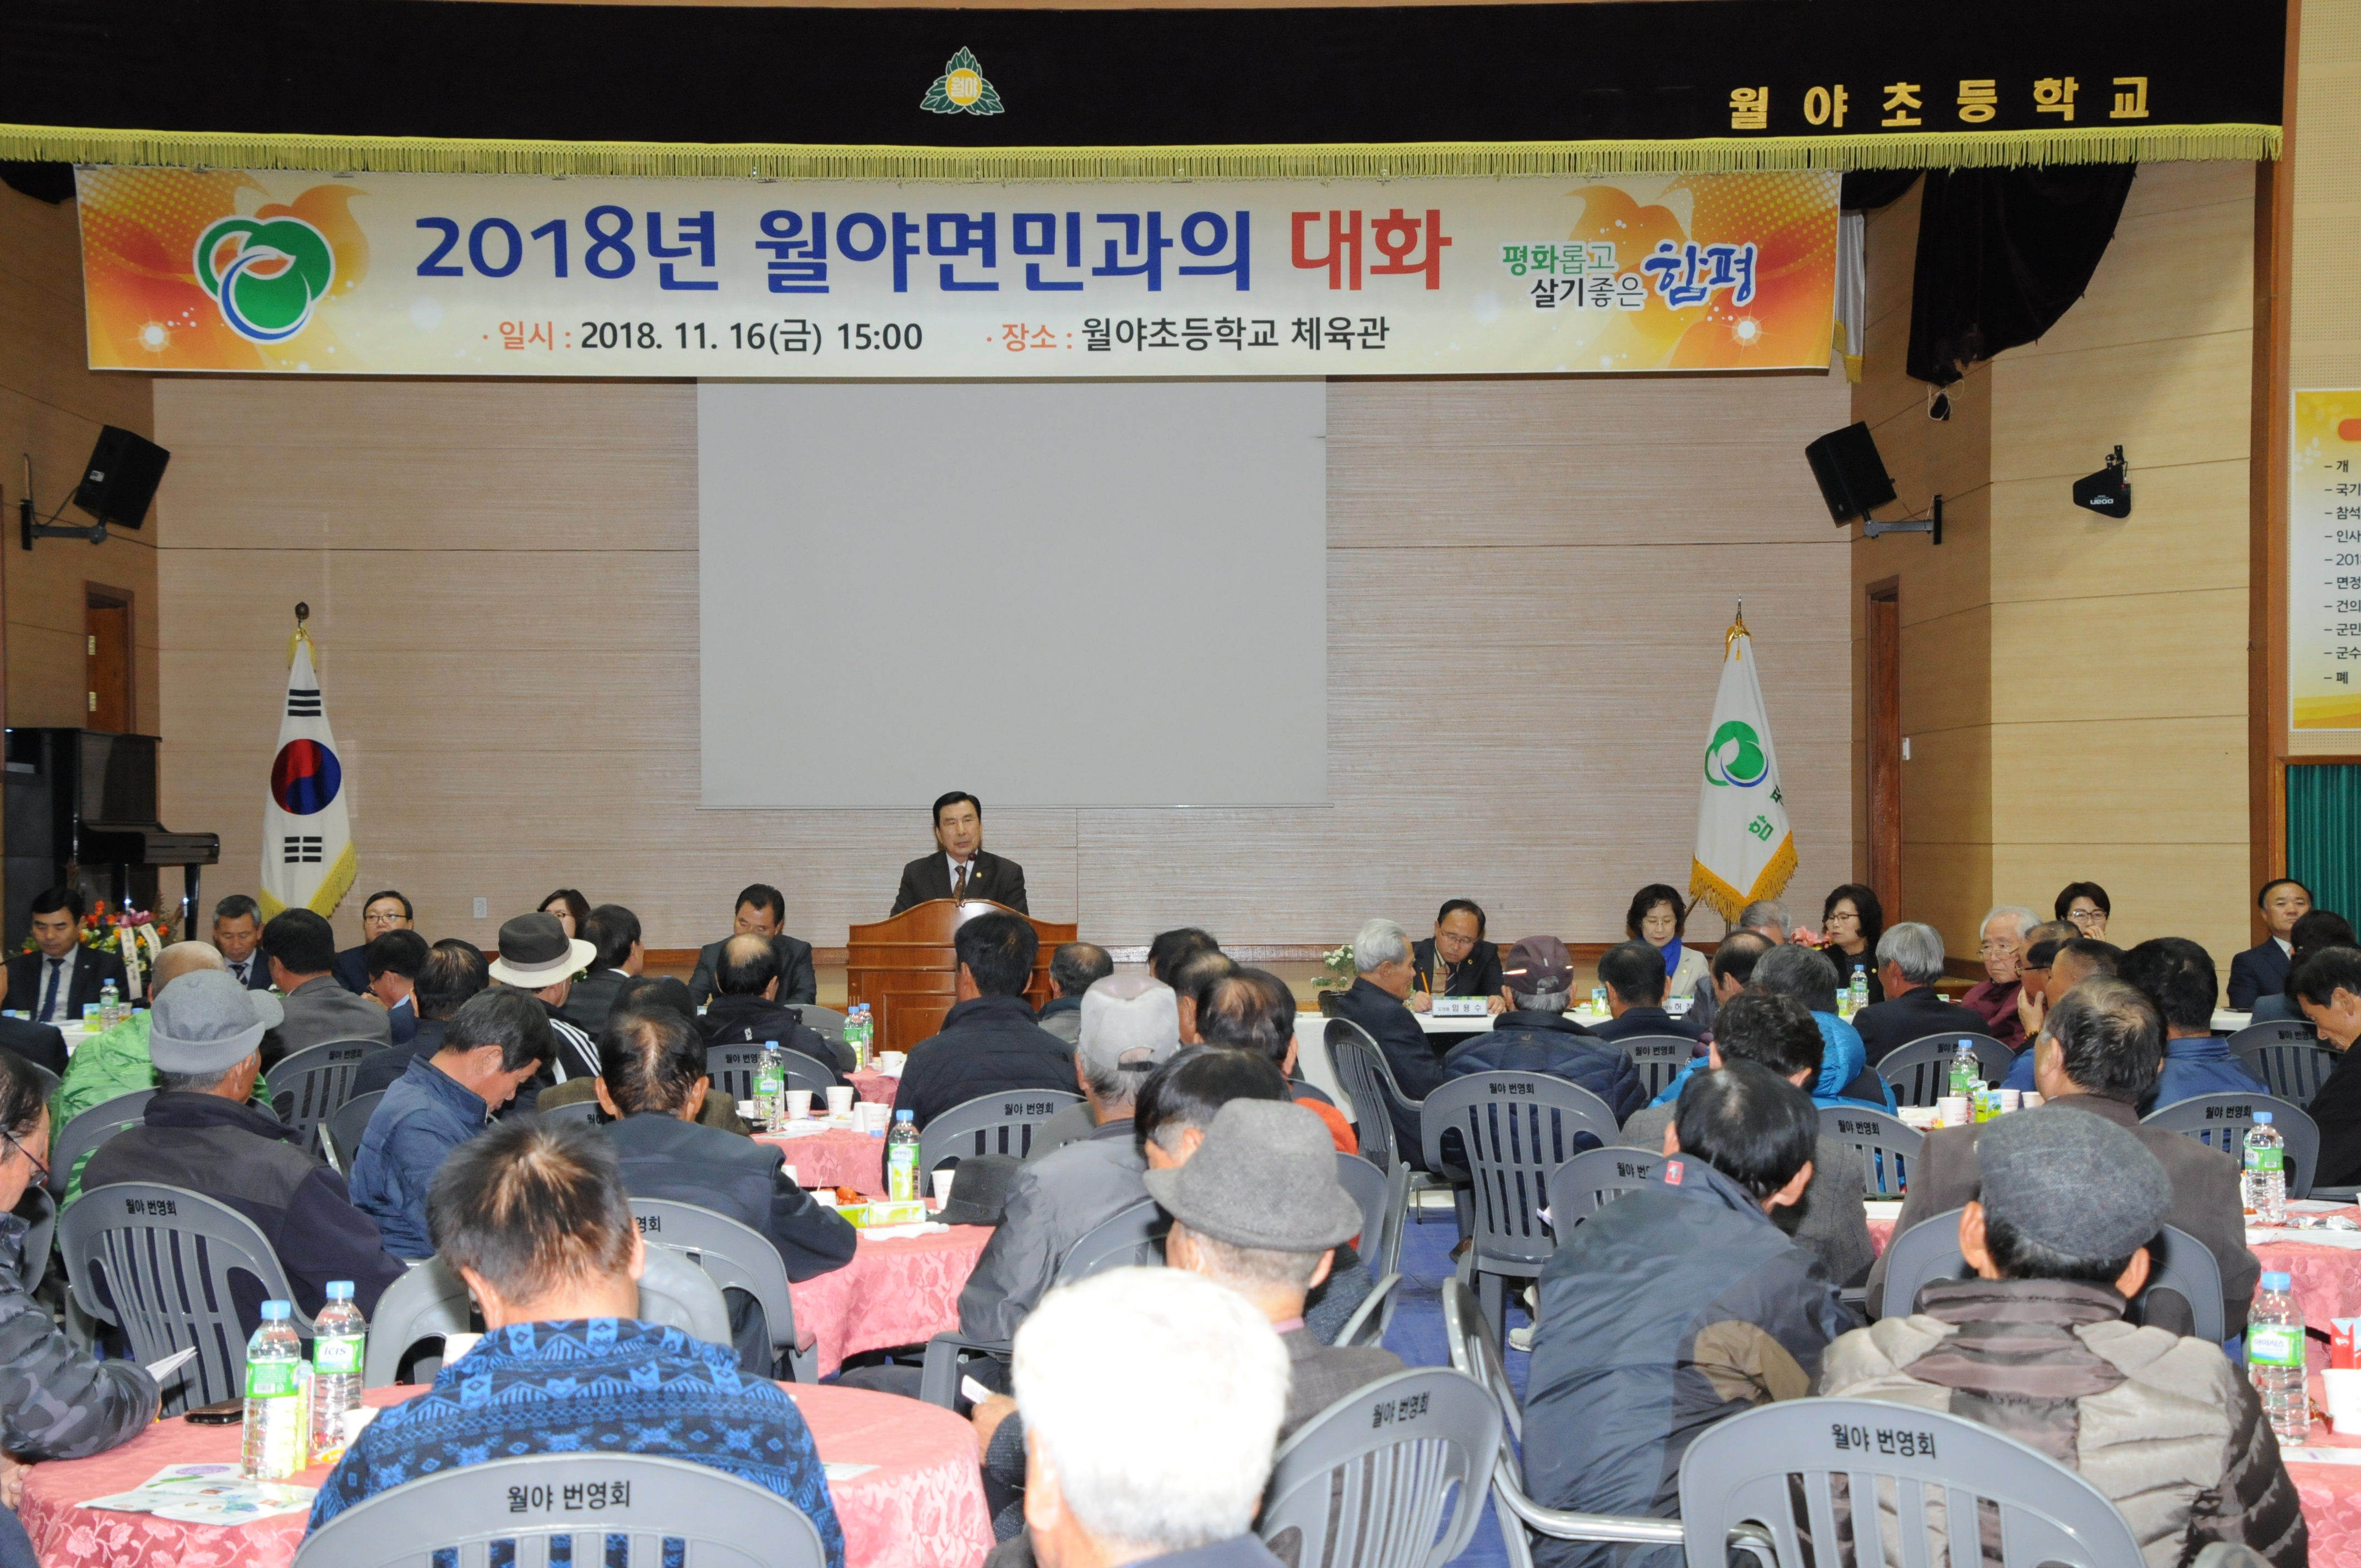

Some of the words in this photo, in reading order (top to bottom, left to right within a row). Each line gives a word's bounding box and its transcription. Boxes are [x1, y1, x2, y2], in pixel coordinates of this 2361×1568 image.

[951, 77, 978, 98] 월야
[415, 205, 719, 291] 2018년
[755, 209, 1250, 294] 월야면민과의
[1291, 208, 1452, 291] 대화
[1502, 244, 1615, 276] 평화롭고
[1645, 243, 1754, 306] 함평
[1530, 277, 1644, 308] 살기좋은
[730, 318, 823, 356] 16(금)
[837, 323, 923, 351] 15:00
[1081, 316, 1280, 352] 월야초등학교
[1291, 315, 1390, 351] 체육관
[2336, 553, 2361, 566] 201
[725, 1054, 741, 1064] 월야
[1635, 1046, 1650, 1056] 월야
[1653, 1046, 1675, 1056] 번영회
[1489, 1083, 1506, 1095] 월야
[1508, 1083, 1535, 1095] 번영회
[1004, 1103, 1023, 1115] 월야
[1026, 1102, 1054, 1115] 번영회
[2206, 1106, 2223, 1119] 월야
[2226, 1105, 2251, 1118] 번영회
[1837, 1120, 1853, 1134] 월야
[1856, 1121, 1880, 1136] 번영회
[1617, 1162, 1634, 1178] 월야
[126, 1199, 145, 1215] 월야
[146, 1199, 177, 1216] 번영회
[635, 1215, 661, 1234] 영회
[1831, 1423, 1870, 1452] 월야
[1876, 1428, 1936, 1459] 번영회
[507, 1484, 553, 1513] 월야
[563, 1480, 632, 1510] 번영회
